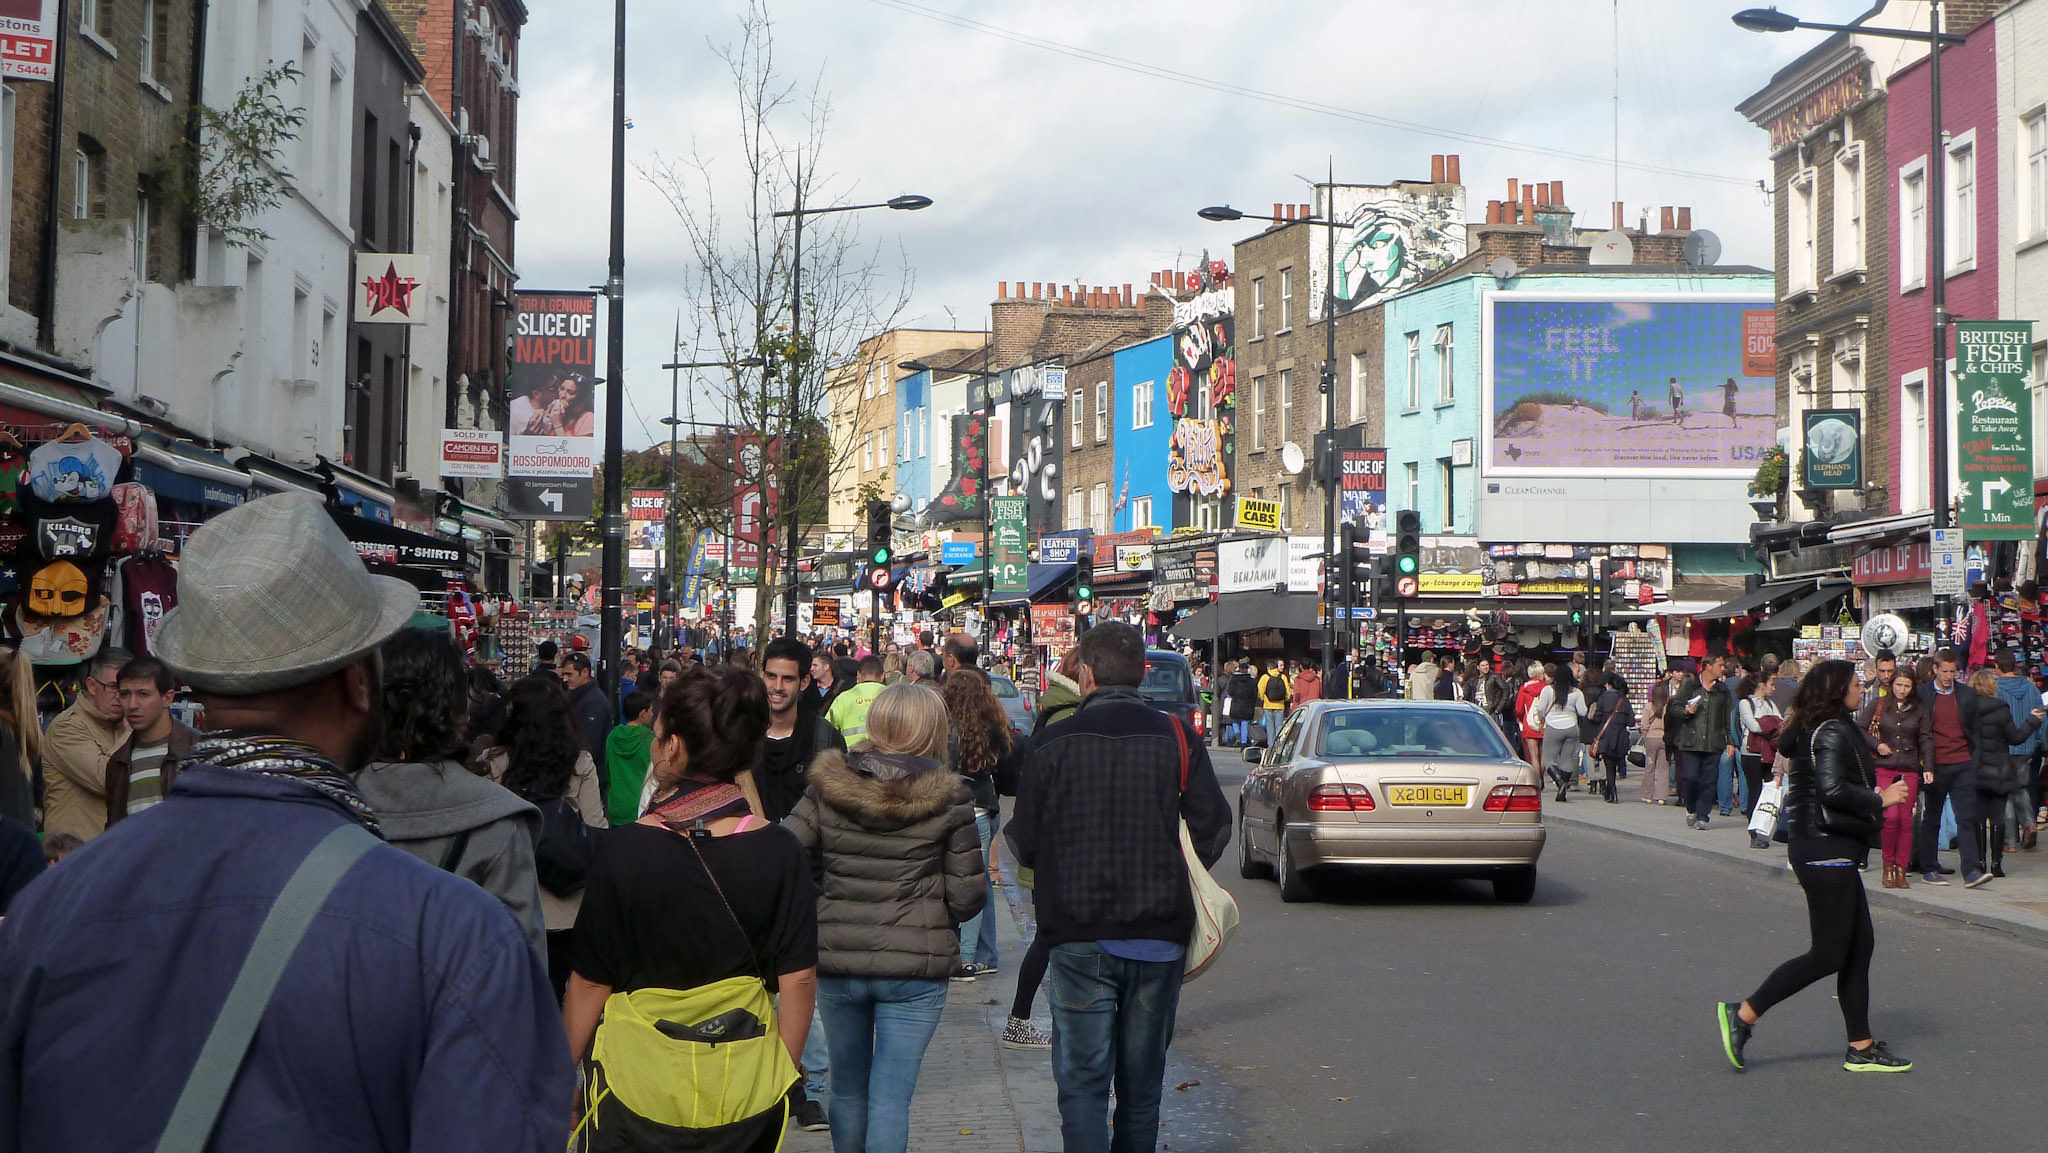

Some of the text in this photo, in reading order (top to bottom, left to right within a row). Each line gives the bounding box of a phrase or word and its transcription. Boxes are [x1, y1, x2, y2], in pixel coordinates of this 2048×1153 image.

[0, 39, 48, 58] LET
[17, 65, 48, 76] 5444
[366, 276, 415, 309] PRET
[518, 298, 592, 313] FOR A GENUINE
[517, 312, 592, 337] SLICE OF
[1960, 331, 2028, 344] BRITISH
[515, 337, 592, 365] NAPOLI
[1965, 344, 2023, 363] FISH
[1966, 363, 2023, 374] & CHIPS
[1972, 389, 2017, 411] Poppies
[1971, 415, 2018, 425] Restaurant
[1998, 425, 2018, 434] Away
[446, 444, 497, 455] CAMDEN BUS
[513, 455, 590, 467] ROSSOPOMODORO
[1342, 460, 1385, 474] SLICE OF
[1343, 474, 1385, 490] NAPOLI
[632, 497, 665, 508] SLICE OF
[1245, 500, 1276, 513] MINI
[632, 508, 665, 520] NAPOLI
[997, 506, 1022, 515] FISH
[1243, 512, 1275, 524] CABS
[1984, 513, 2011, 522] 1 Min
[46, 523, 92, 534] KILLERS
[1042, 540, 1076, 549] LEATHER
[399, 545, 459, 561] T-SHIRTS
[1049, 548, 1071, 558] SHOP
[1233, 568, 1277, 583] BENJAMIN
[1396, 788, 1463, 800] X201 GLH
